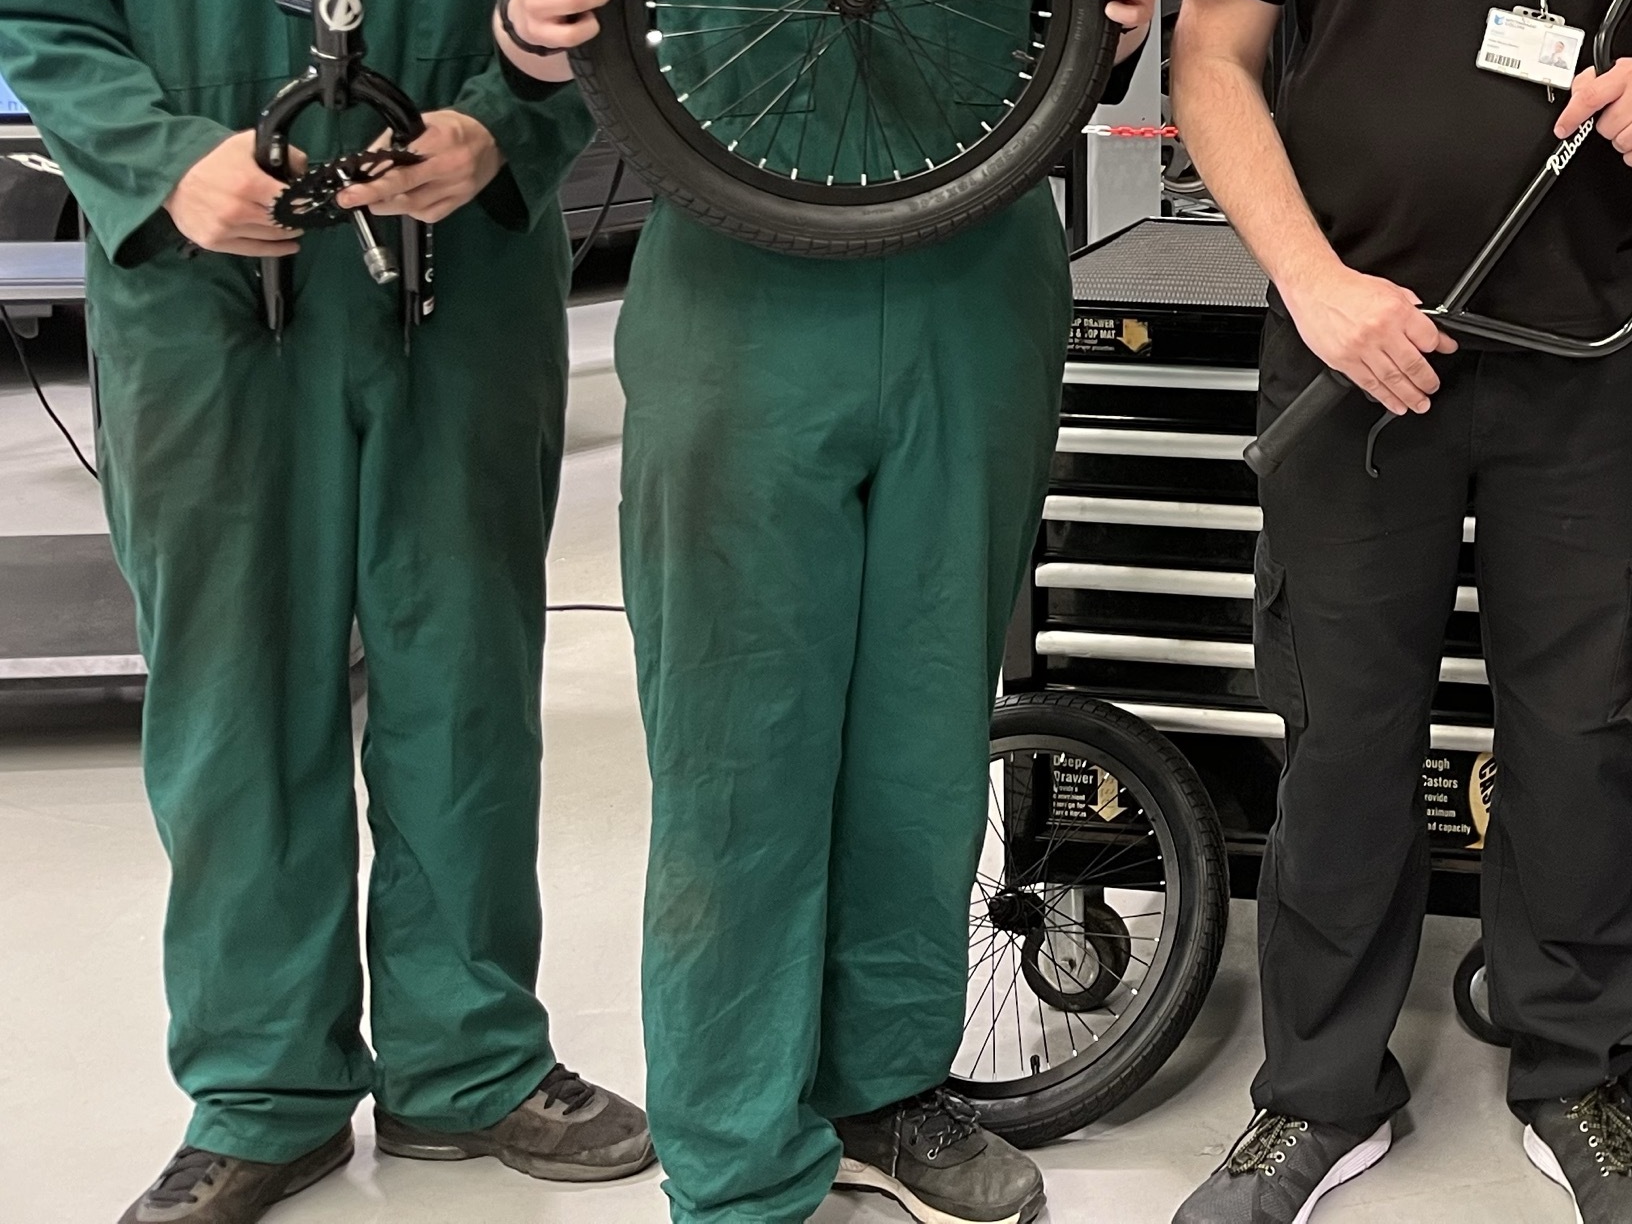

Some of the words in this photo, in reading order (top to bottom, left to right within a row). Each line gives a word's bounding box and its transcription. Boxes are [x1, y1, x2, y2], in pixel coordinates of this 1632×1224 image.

[1546, 117, 1594, 176] Rubato
[1100, 330, 1116, 339] MAT
[1425, 758, 1450, 772] ough
[1424, 793, 1448, 803] rovide
[1426, 807, 1456, 817] aximum
[1438, 823, 1471, 835] capacity
